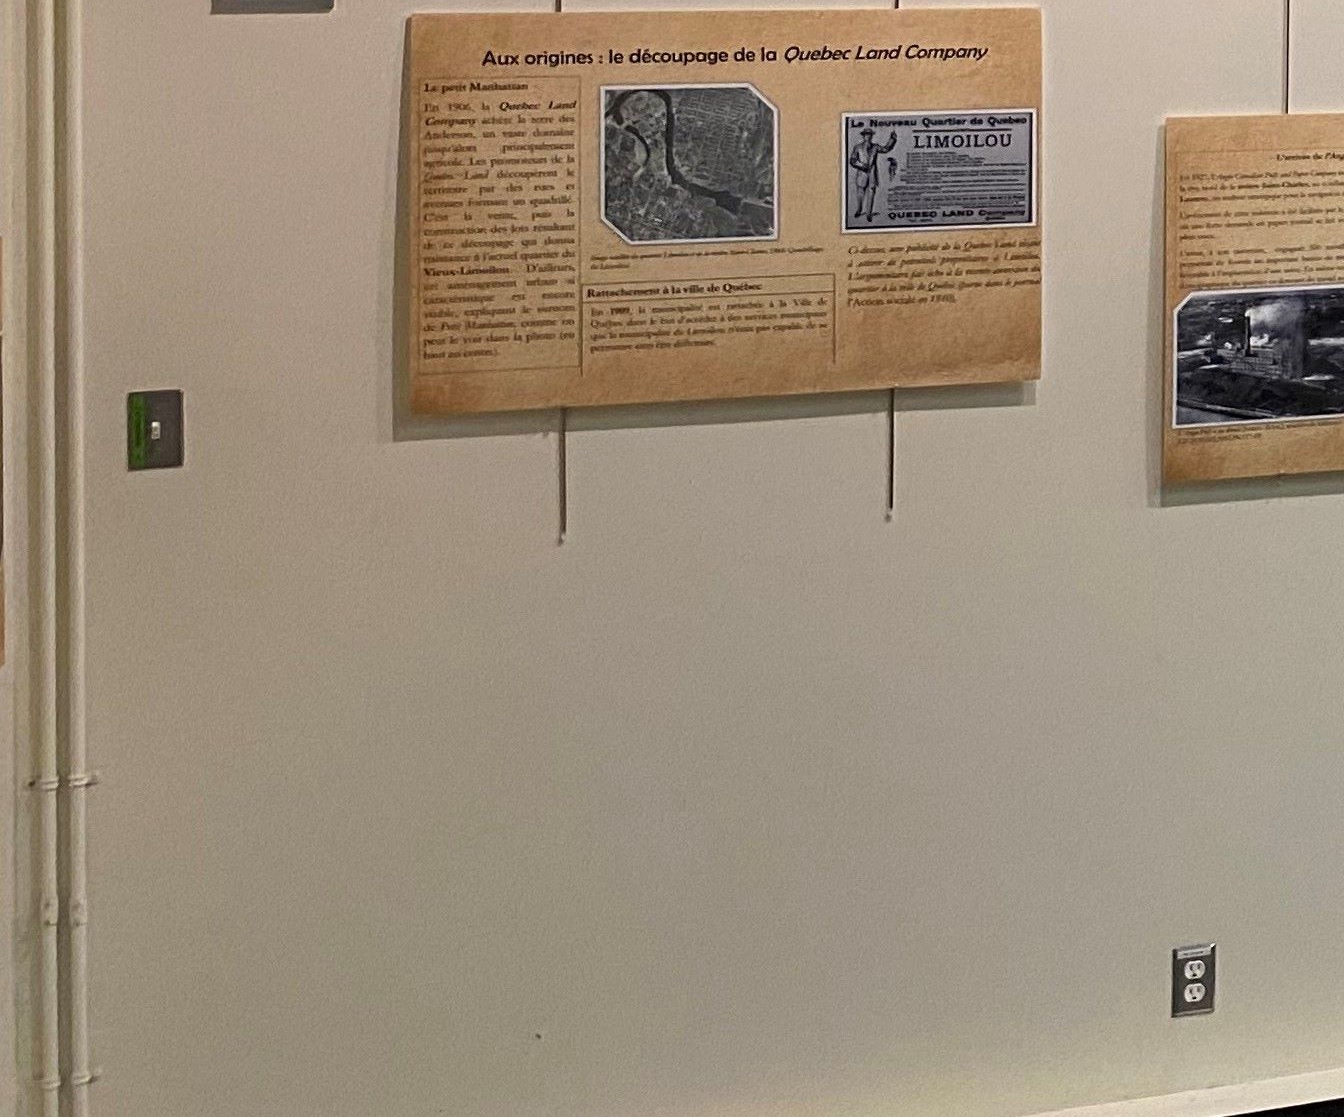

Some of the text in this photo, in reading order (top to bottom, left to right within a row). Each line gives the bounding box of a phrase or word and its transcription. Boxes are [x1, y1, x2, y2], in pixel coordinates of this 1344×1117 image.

[482, 50, 519, 66] Aux
[524, 50, 593, 67] origines
[609, 49, 624, 63] le
[629, 48, 729, 67] découpage
[734, 47, 755, 61] de
[761, 47, 777, 61] la
[784, 45, 851, 63] Quebec
[855, 45, 901, 60] Land
[904, 44, 988, 61] Company
[850, 119, 864, 128] Le
[869, 119, 917, 127] Nouveau
[922, 117, 966, 128] Quartier
[970, 117, 984, 125] de
[913, 134, 1012, 149] LIMOILOU
[662, 286, 669, 294] à
[671, 285, 682, 294] la
[707, 284, 720, 292] de
